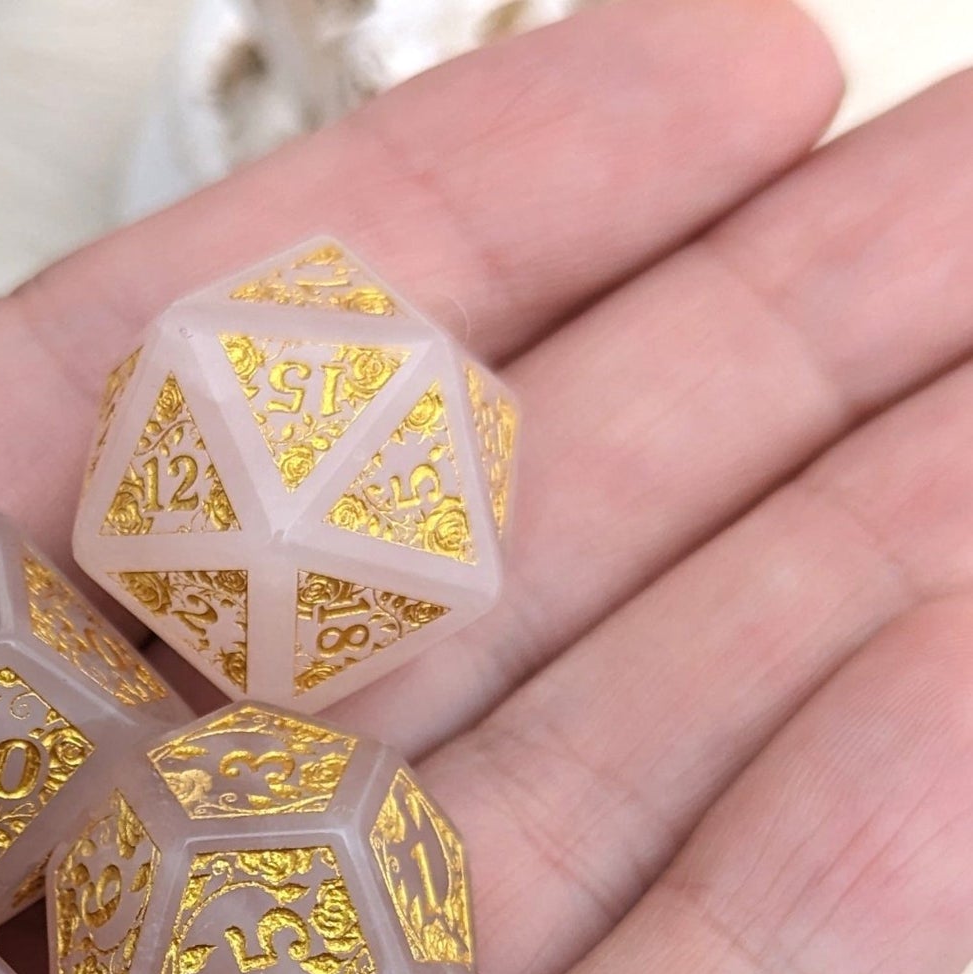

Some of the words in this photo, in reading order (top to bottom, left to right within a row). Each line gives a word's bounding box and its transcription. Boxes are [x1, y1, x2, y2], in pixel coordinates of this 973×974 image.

[267, 360, 347, 417] 15
[141, 455, 198, 512] 12
[390, 464, 442, 509] 5
[171, 594, 218, 636] 2
[315, 598, 372, 657] 18
[219, 751, 295, 785] 3
[410, 842, 442, 918] 1
[225, 908, 311, 973] 5
